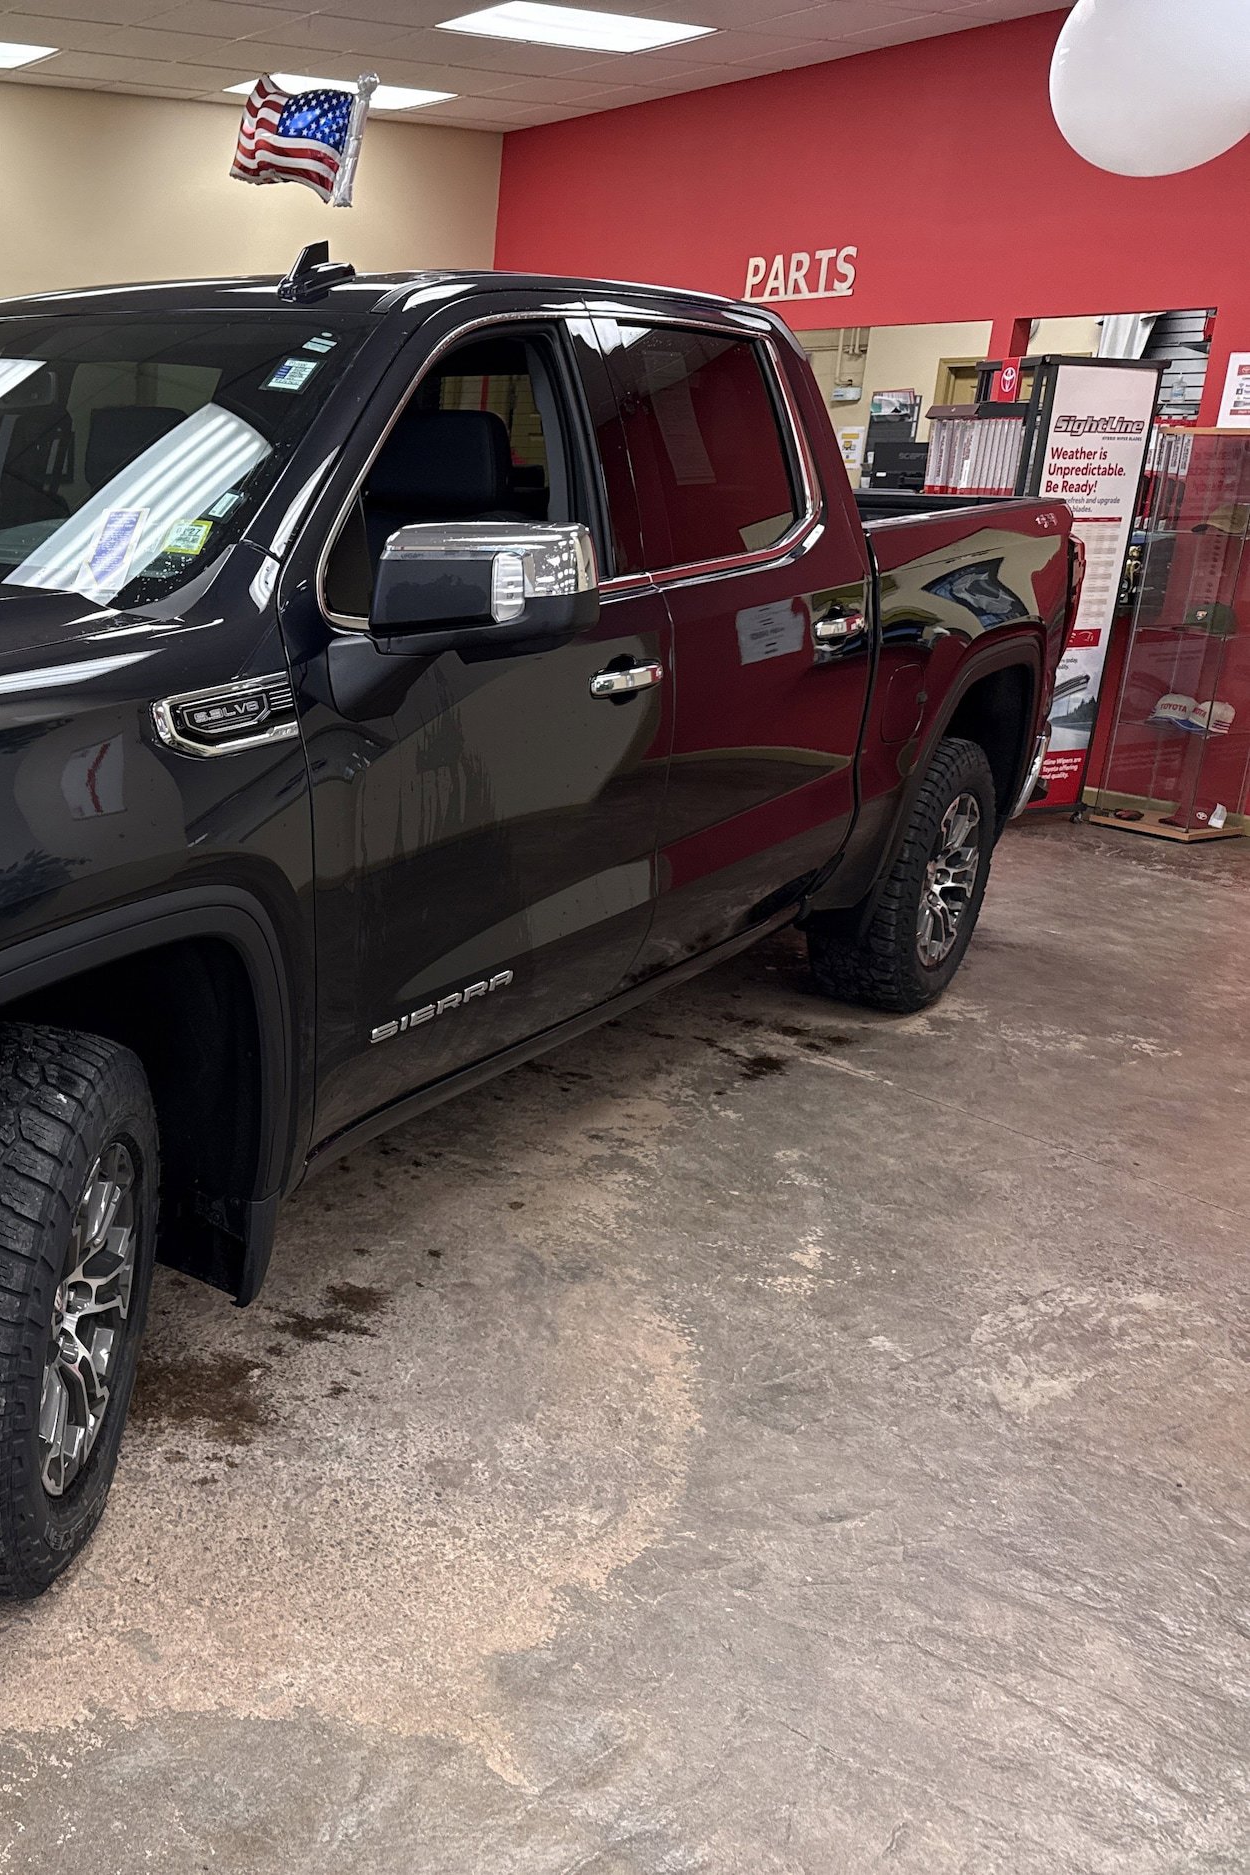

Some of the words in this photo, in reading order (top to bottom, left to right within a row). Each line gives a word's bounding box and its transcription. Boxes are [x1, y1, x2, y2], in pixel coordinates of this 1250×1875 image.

[743, 246, 857, 300] PARTS
[1051, 446, 1098, 460] Weather
[1099, 446, 1108, 460] is
[1048, 463, 1126, 479] Unpredictable.
[1045, 480, 1059, 493] Be
[1061, 480, 1098, 496] Ready!
[1160, 703, 1188, 713] TOYOTA
[370, 969, 514, 1044] SIERRA
